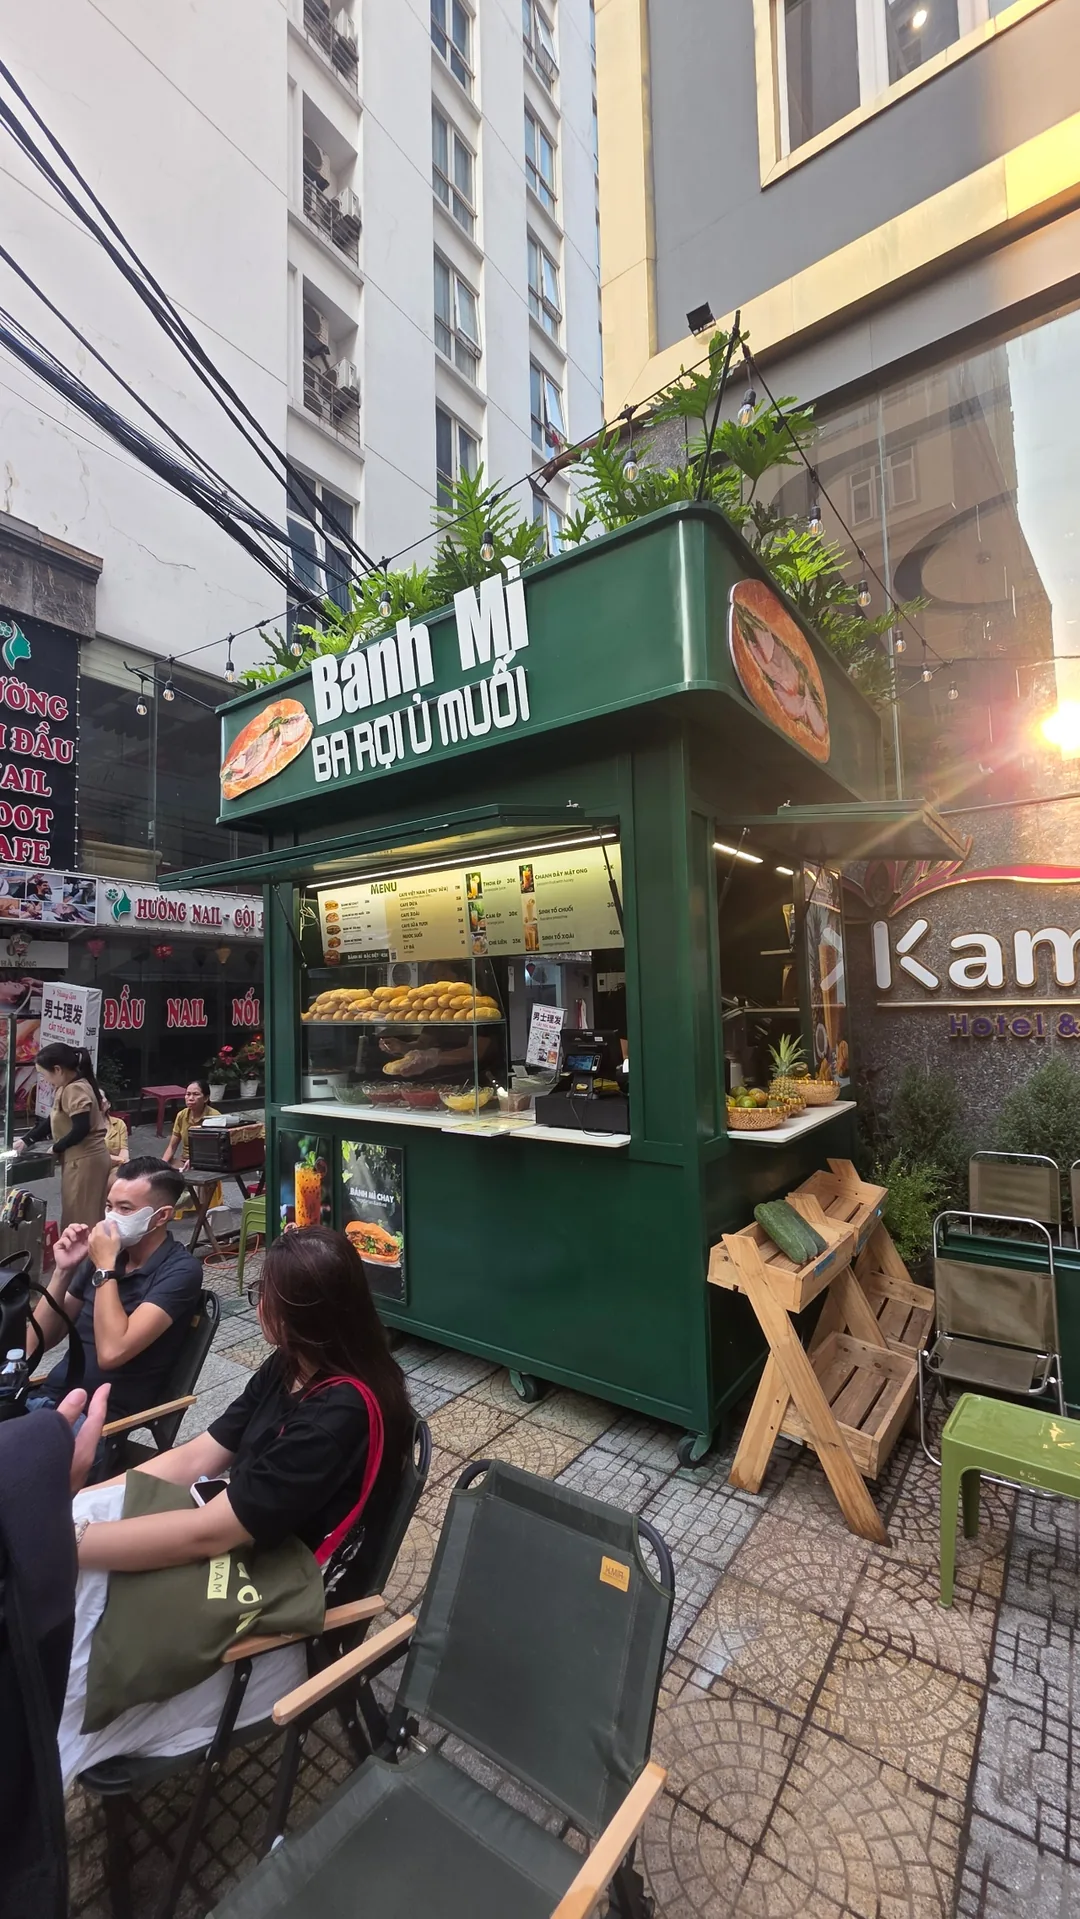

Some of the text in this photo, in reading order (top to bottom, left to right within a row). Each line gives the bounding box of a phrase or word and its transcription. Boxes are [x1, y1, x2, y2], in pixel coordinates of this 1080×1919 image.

[311, 616, 434, 726] Bánh
[312, 650, 530, 783] BA RỌI Ủ MUỐI
[10, 720, 75, 764] ĐẦU
[370, 882, 397, 895] MENU
[534, 872, 552, 880] CHANH
[135, 895, 187, 921] HƯỜNG
[190, 904, 222, 927] NAIL
[44, 999, 83, 1025] 男士理发
[104, 984, 146, 1030] ĐẦU
[167, 998, 208, 1027] NAIL
[948, 1012, 1045, 1037] Hotel
[349, 1187, 367, 1198] BÁNH
[377, 1193, 394, 1203] CHAY
[213, 1561, 224, 1593] NAM
